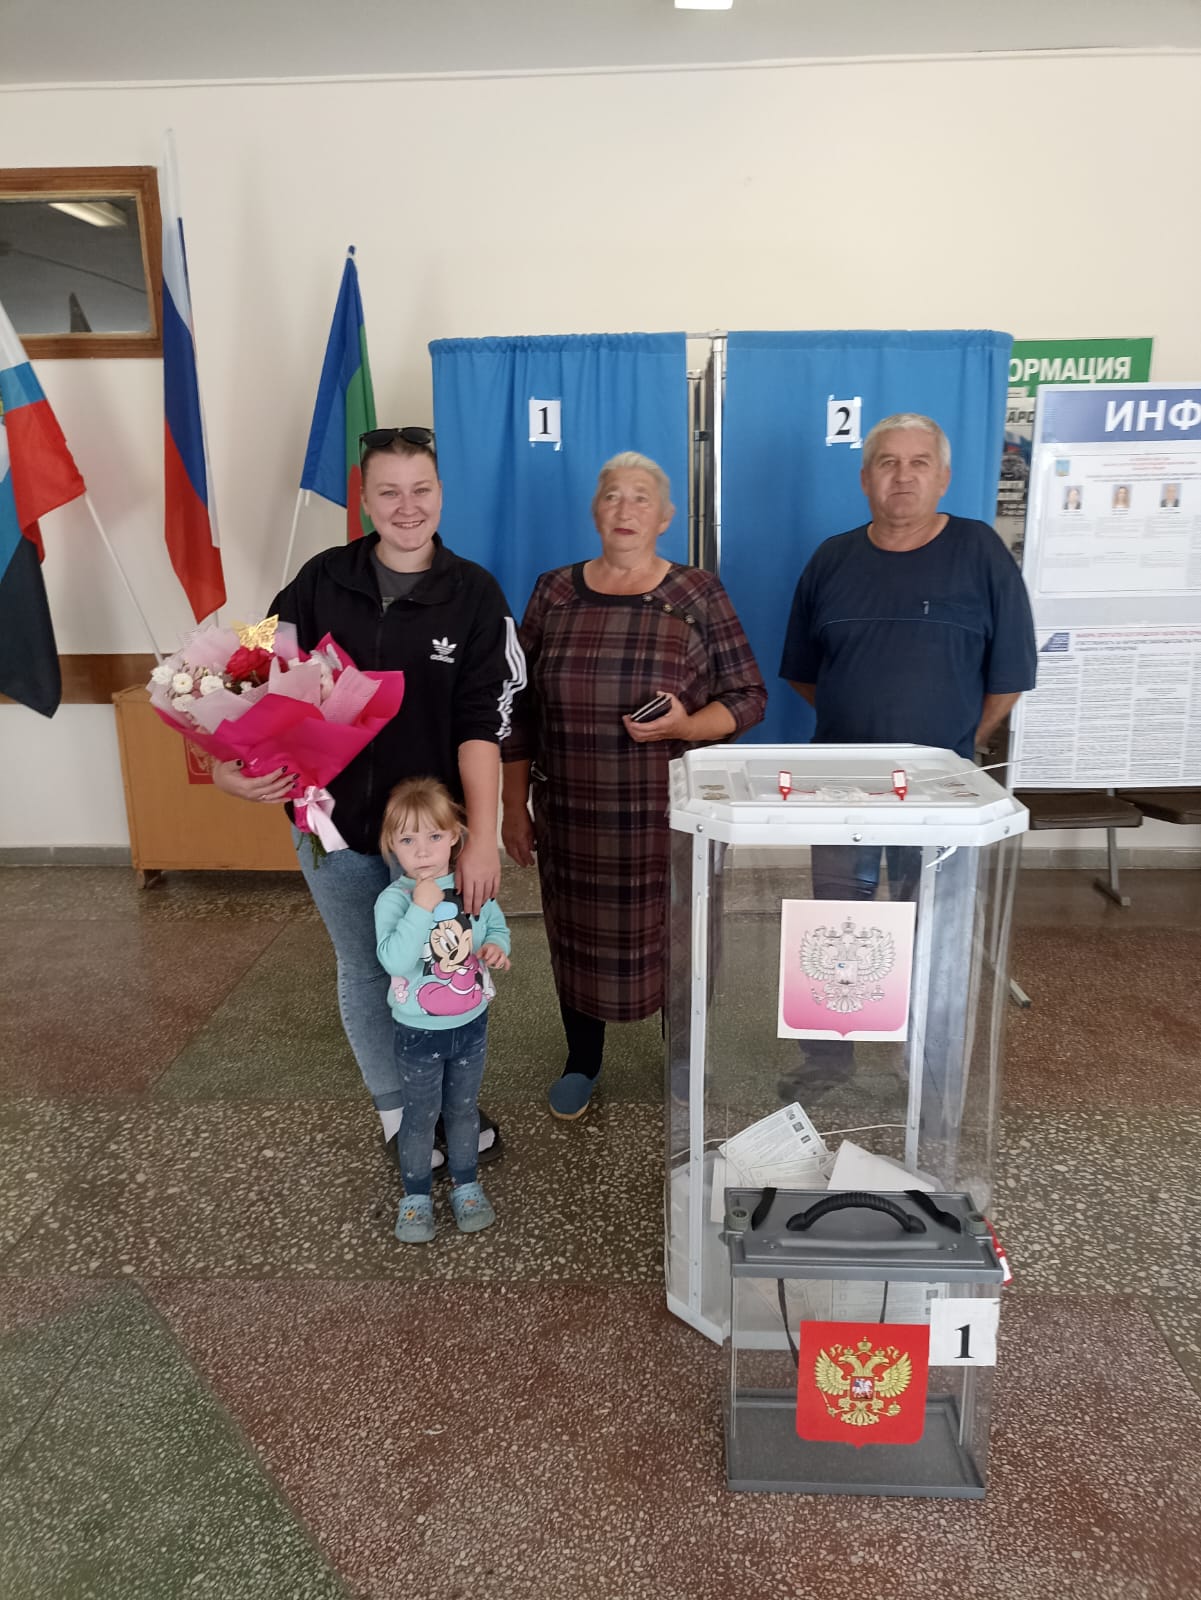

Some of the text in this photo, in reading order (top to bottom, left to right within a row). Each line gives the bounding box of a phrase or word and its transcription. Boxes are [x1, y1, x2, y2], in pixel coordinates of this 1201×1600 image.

[538, 406, 551, 435] 1
[834, 406, 852, 436] 2
[1105, 399, 1201, 432] ИНФ
[954, 1323, 975, 1359] 1
